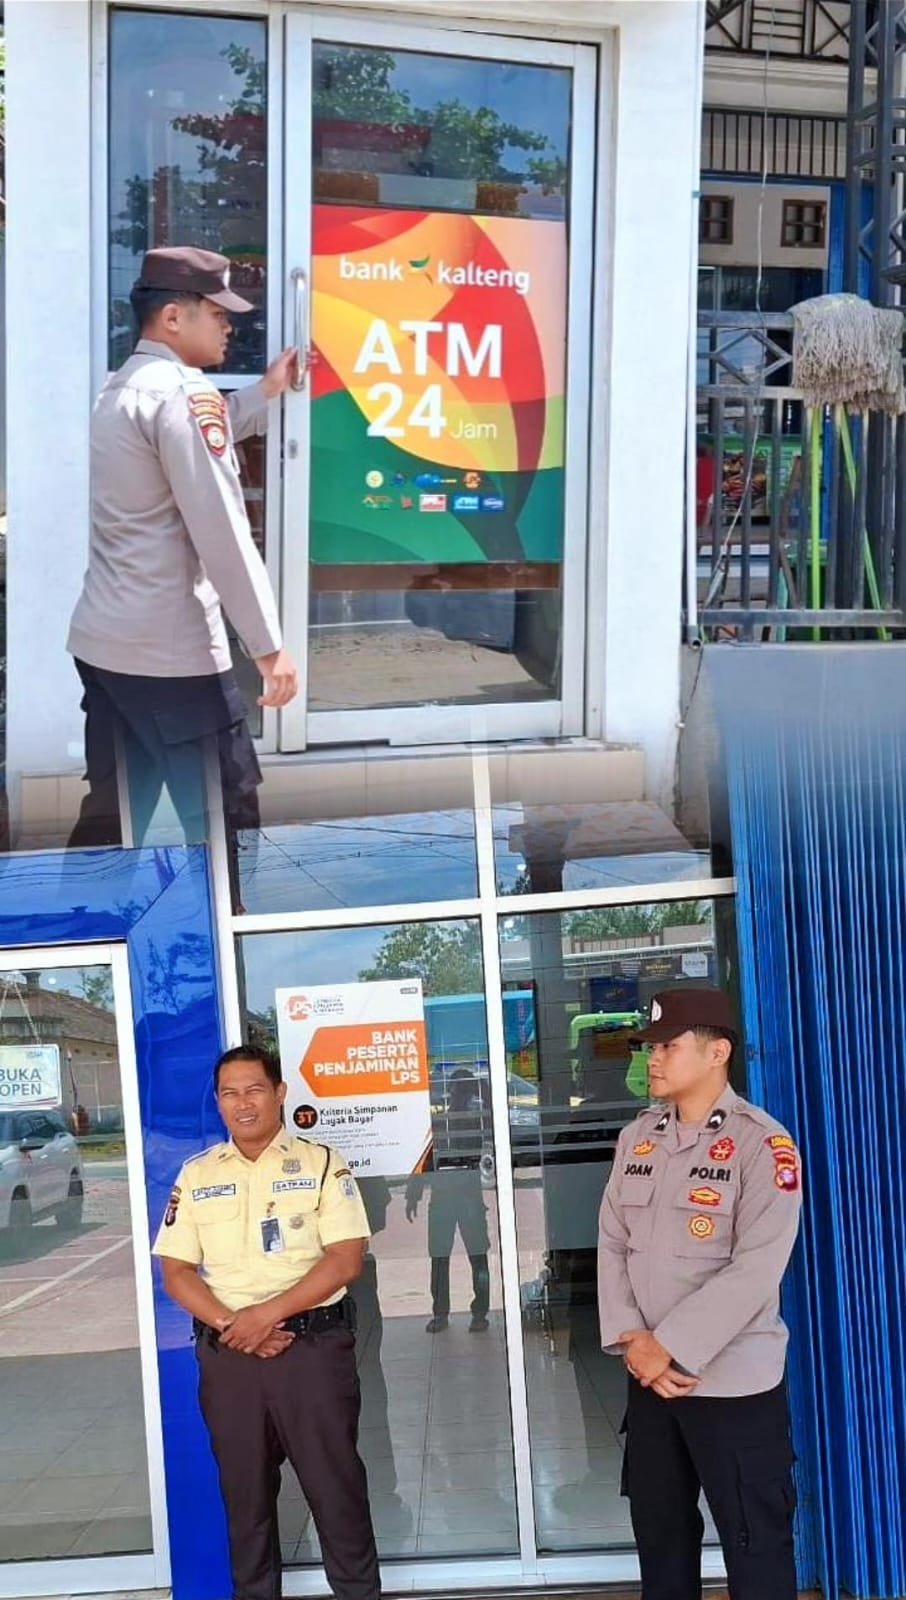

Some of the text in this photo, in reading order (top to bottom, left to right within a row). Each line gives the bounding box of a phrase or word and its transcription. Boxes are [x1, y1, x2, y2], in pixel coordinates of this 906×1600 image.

[340, 256, 530, 294] bank kalteng
[353, 318, 503, 378] ATM
[366, 382, 497, 439] 24 Jam
[372, 1030, 418, 1044] BANK
[347, 1044, 418, 1059] PESERTA
[313, 1058, 419, 1077] PENJAMINAN
[391, 1071, 420, 1085] LPS
[0, 1083, 42, 1096] OPEN
[320, 1105, 398, 1116] Kriteria Simpanan
[320, 1115, 374, 1127] Layak Bayar
[624, 1163, 653, 1176] JOAN
[689, 1167, 732, 1182] POLRI
